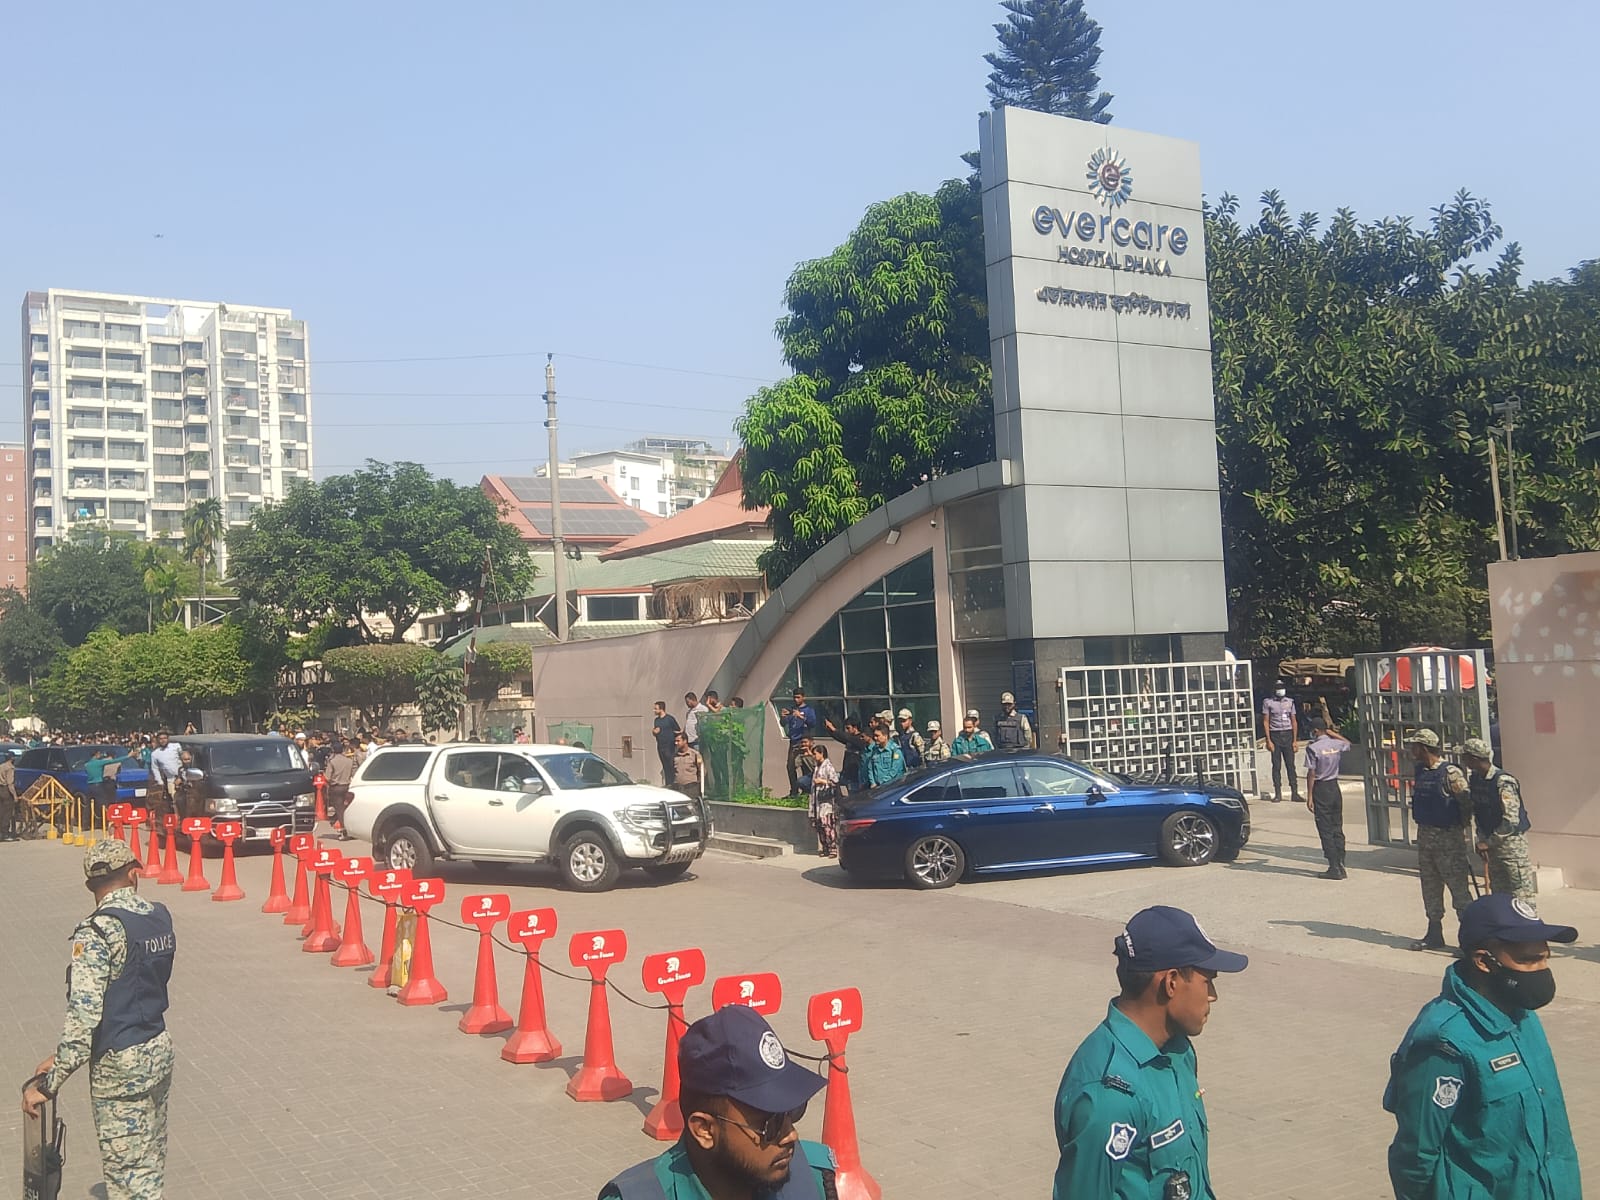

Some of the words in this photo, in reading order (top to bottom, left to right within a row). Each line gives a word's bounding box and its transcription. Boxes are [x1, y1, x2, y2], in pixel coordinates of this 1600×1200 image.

[1032, 205, 1189, 256] evercare
[1057, 245, 1121, 269] HOSPITAL
[1124, 254, 1172, 277] DHAKA
